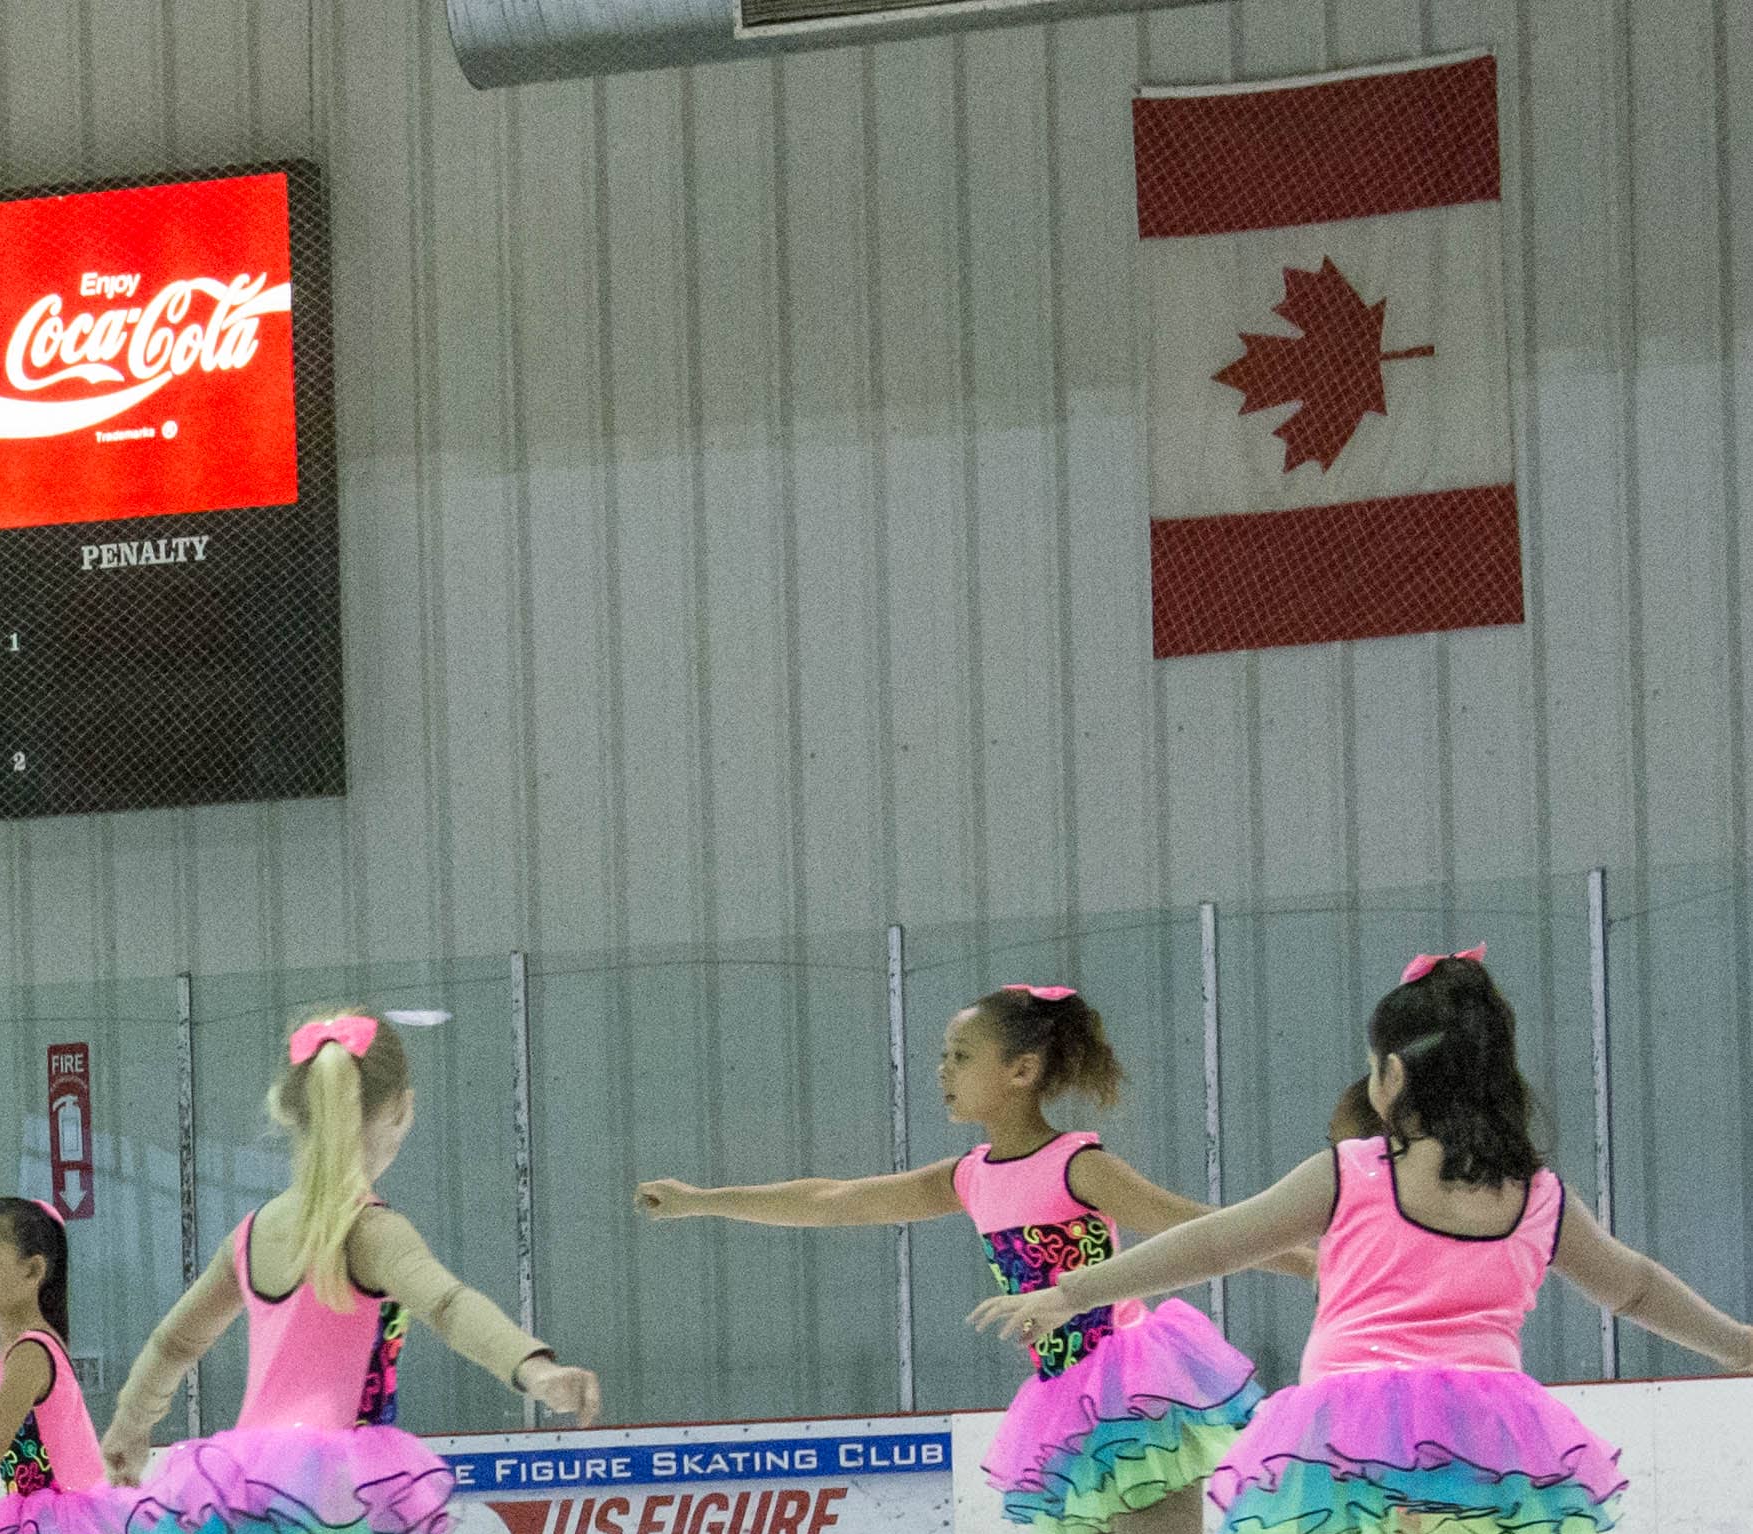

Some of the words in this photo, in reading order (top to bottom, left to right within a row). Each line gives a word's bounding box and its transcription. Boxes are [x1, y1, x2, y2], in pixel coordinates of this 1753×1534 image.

[80, 272, 142, 299] Enjoy
[5, 272, 267, 391] Coca-Cola
[81, 535, 210, 570] PENALTY
[9, 632, 20, 651] 1
[13, 751, 27, 772] 2
[51, 1053, 85, 1075] FIRE
[495, 1457, 632, 1483] FIGURE
[652, 1449, 818, 1476] SKATING
[839, 1443, 944, 1468] CLUB
